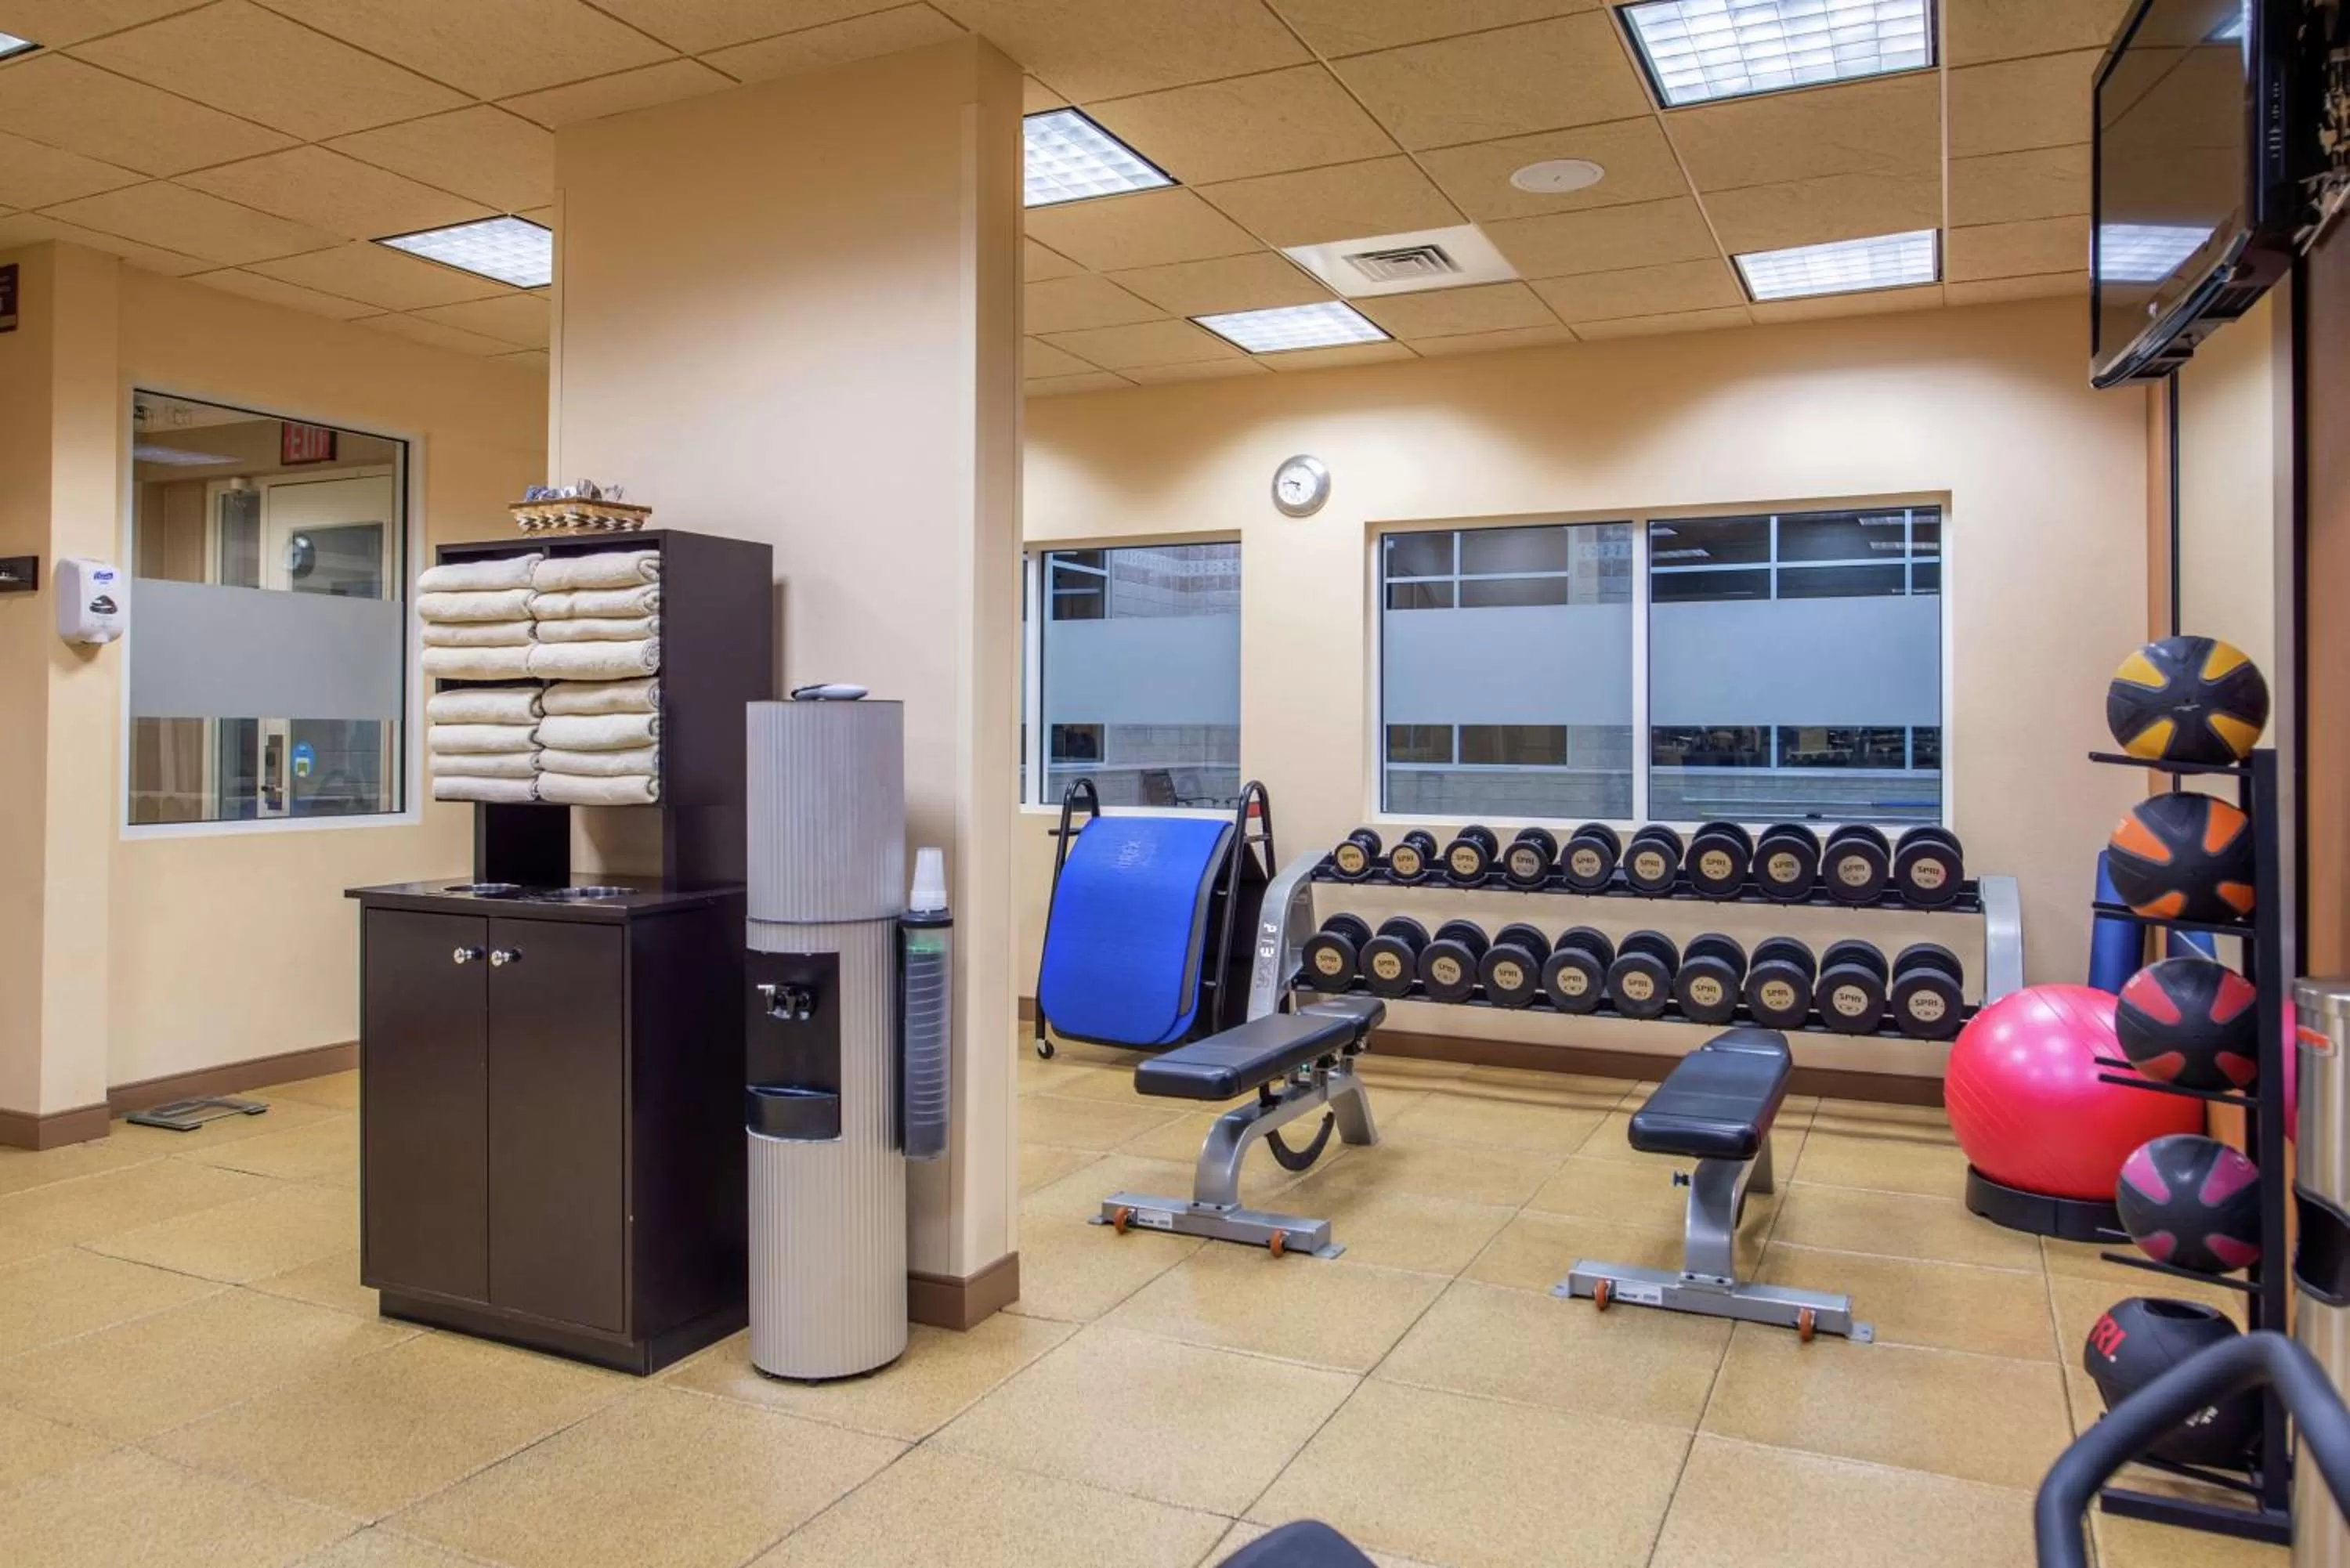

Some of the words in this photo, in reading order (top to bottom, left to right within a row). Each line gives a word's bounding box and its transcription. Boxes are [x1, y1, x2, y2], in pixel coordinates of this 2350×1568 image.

[1628, 978, 1647, 987] SPRI
[1695, 985, 1716, 993] SPRI
[1766, 988, 1788, 997] SPRI
[1839, 992, 1861, 1003] SPRI
